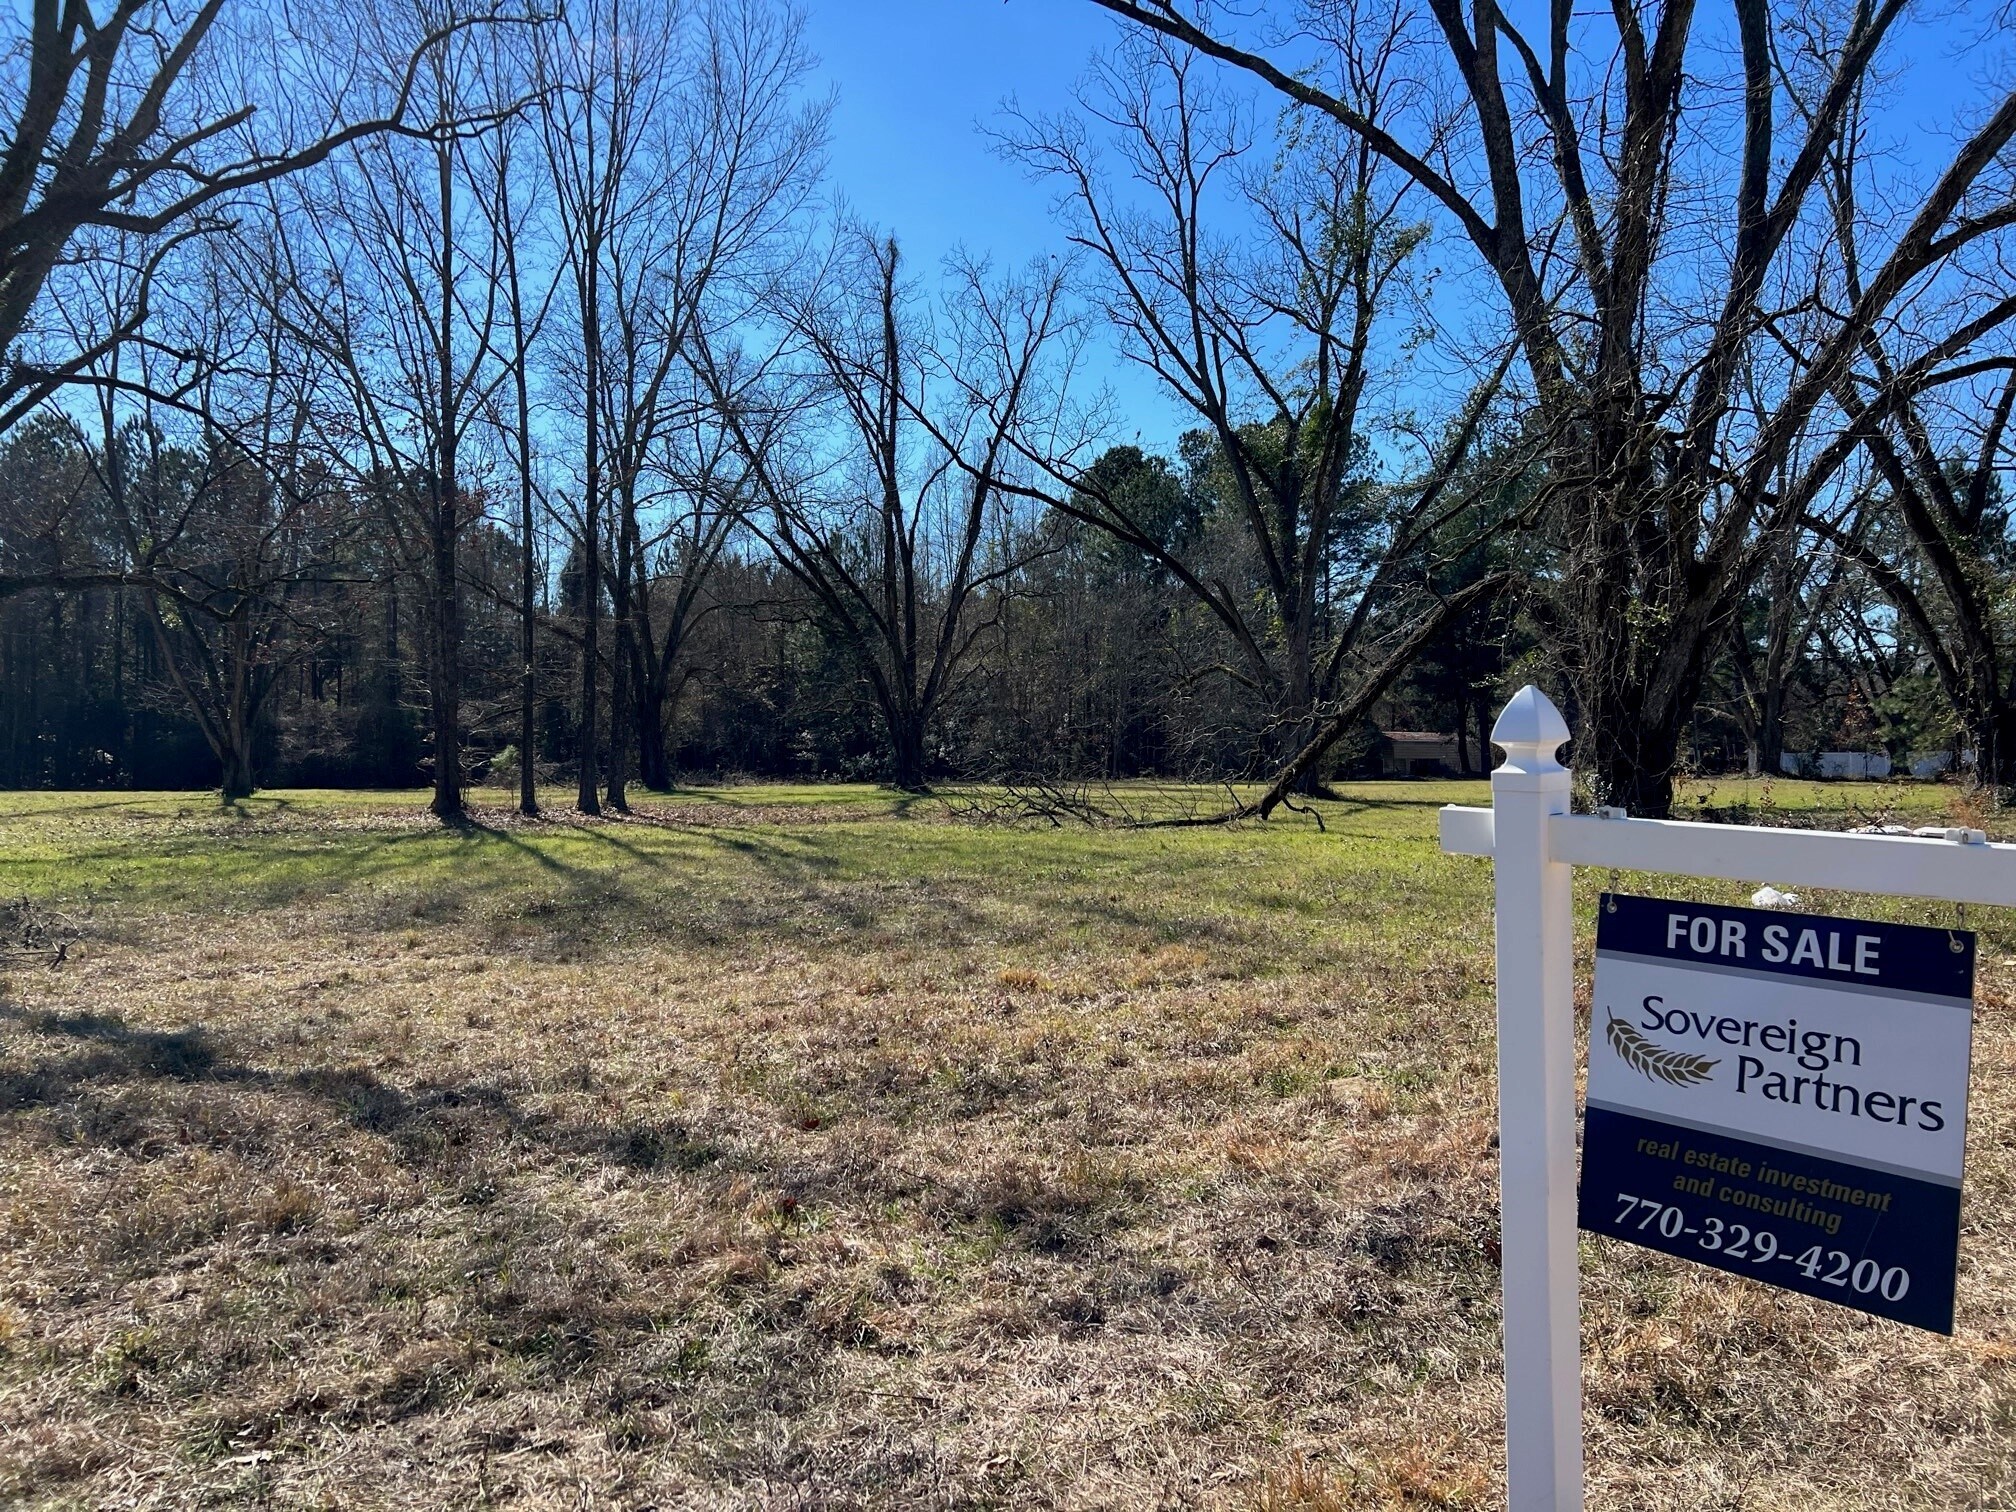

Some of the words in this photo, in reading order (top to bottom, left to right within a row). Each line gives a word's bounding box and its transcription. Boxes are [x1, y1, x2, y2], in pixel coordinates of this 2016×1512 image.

[1666, 914, 1747, 957] FOR
[1761, 925, 1881, 975] SALE
[1641, 996, 1861, 1071] Sovereign
[1735, 1055, 1945, 1132] Partners
[1637, 1135, 1678, 1161] real
[1684, 1149, 1751, 1178] estate
[1757, 1161, 1892, 1212] investment
[1673, 1172, 1714, 1198] and
[1719, 1184, 1842, 1235] consulting
[1614, 1193, 1910, 1302] 770-329-4200
